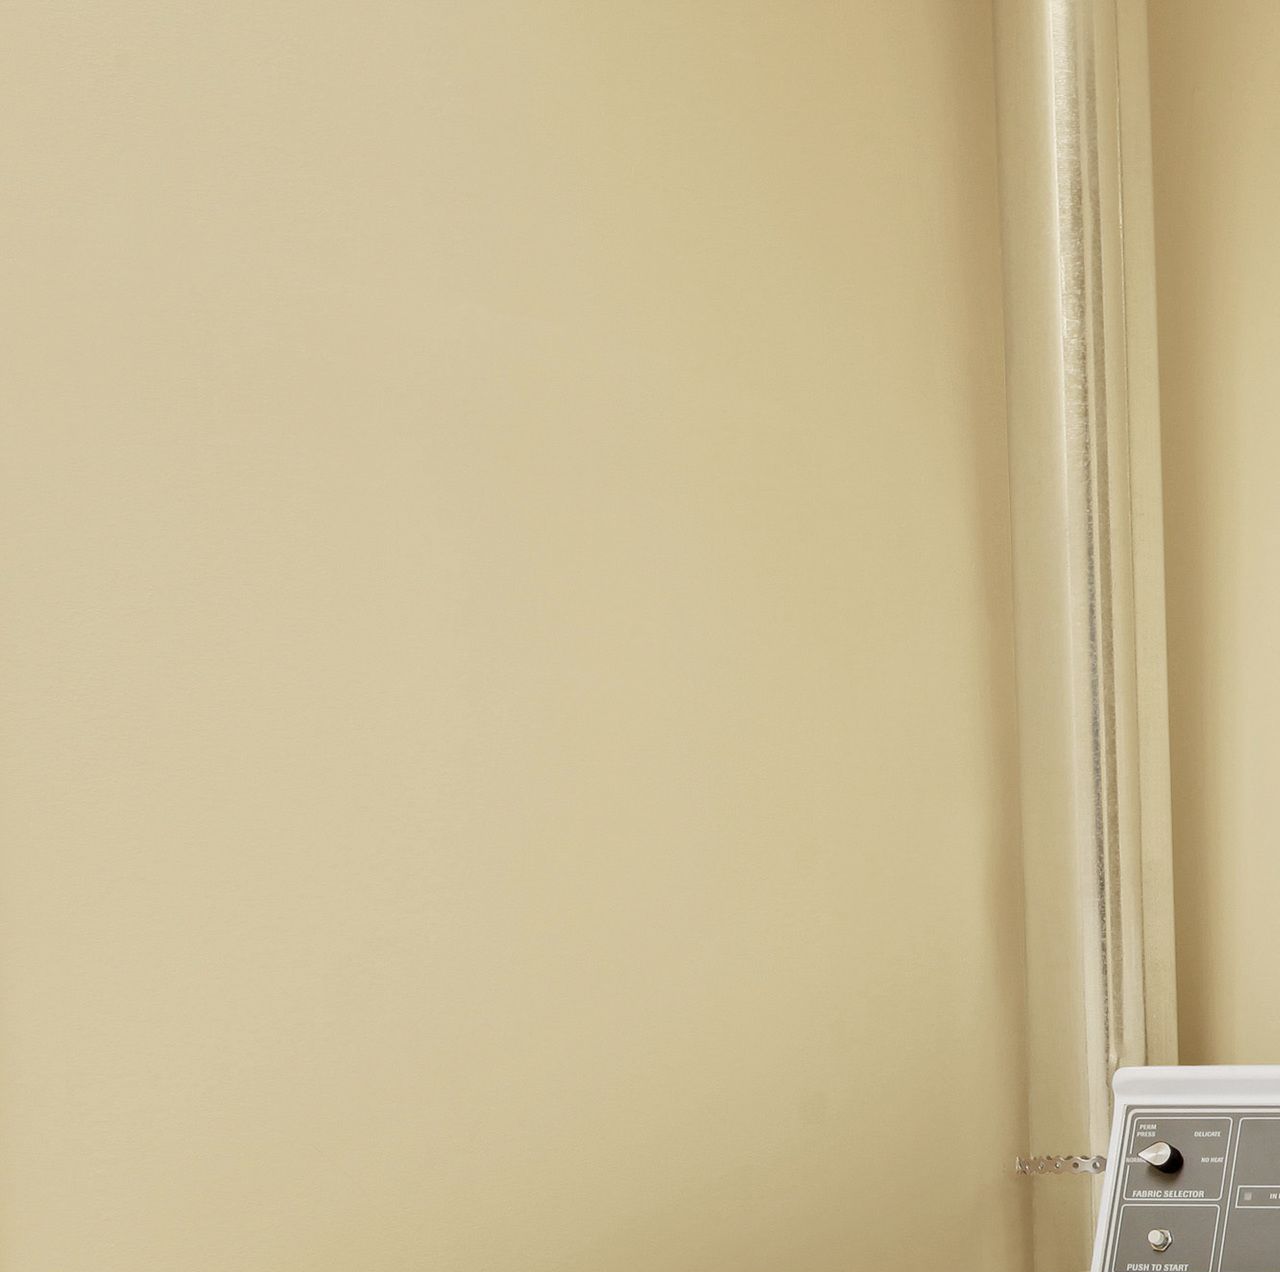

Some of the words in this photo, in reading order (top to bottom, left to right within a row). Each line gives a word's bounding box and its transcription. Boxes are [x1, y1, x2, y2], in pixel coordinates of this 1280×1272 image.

[1132, 1190, 1162, 1198] FABRIC
[1163, 1190, 1205, 1198] SELECTOR
[1126, 1263, 1151, 1272] PUSH
[1151, 1264, 1162, 1272] TO
[1163, 1264, 1190, 1272] START
